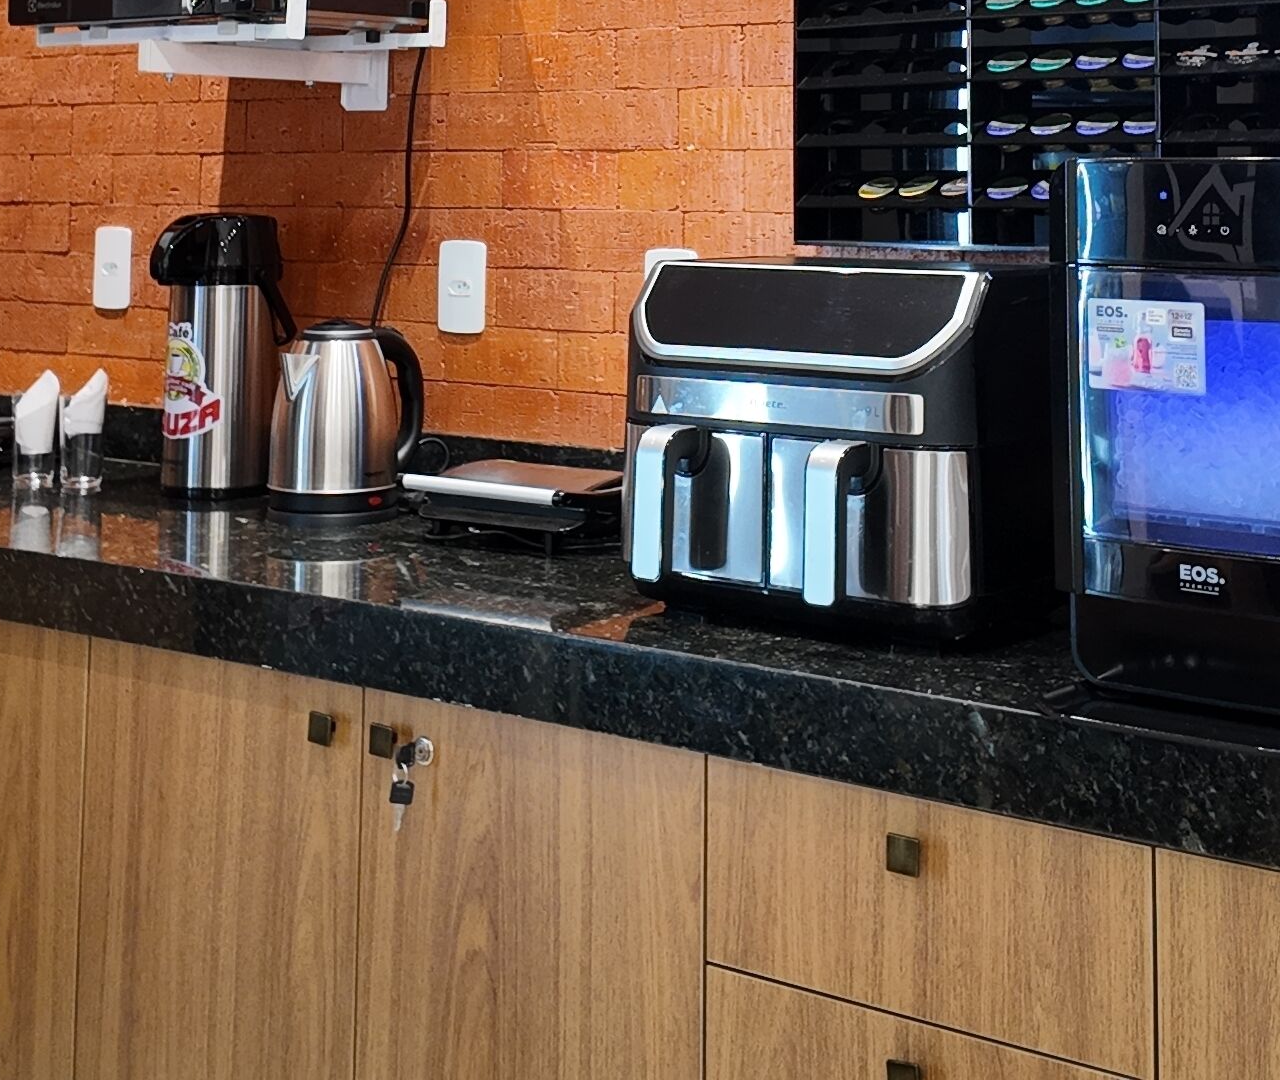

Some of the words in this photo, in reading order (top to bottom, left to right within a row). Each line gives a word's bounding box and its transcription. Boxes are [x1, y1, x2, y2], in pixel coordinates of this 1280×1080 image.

[1096, 305, 1128, 318] EOS.
[162, 398, 220, 437] UZA
[1179, 563, 1226, 585] EOS.
